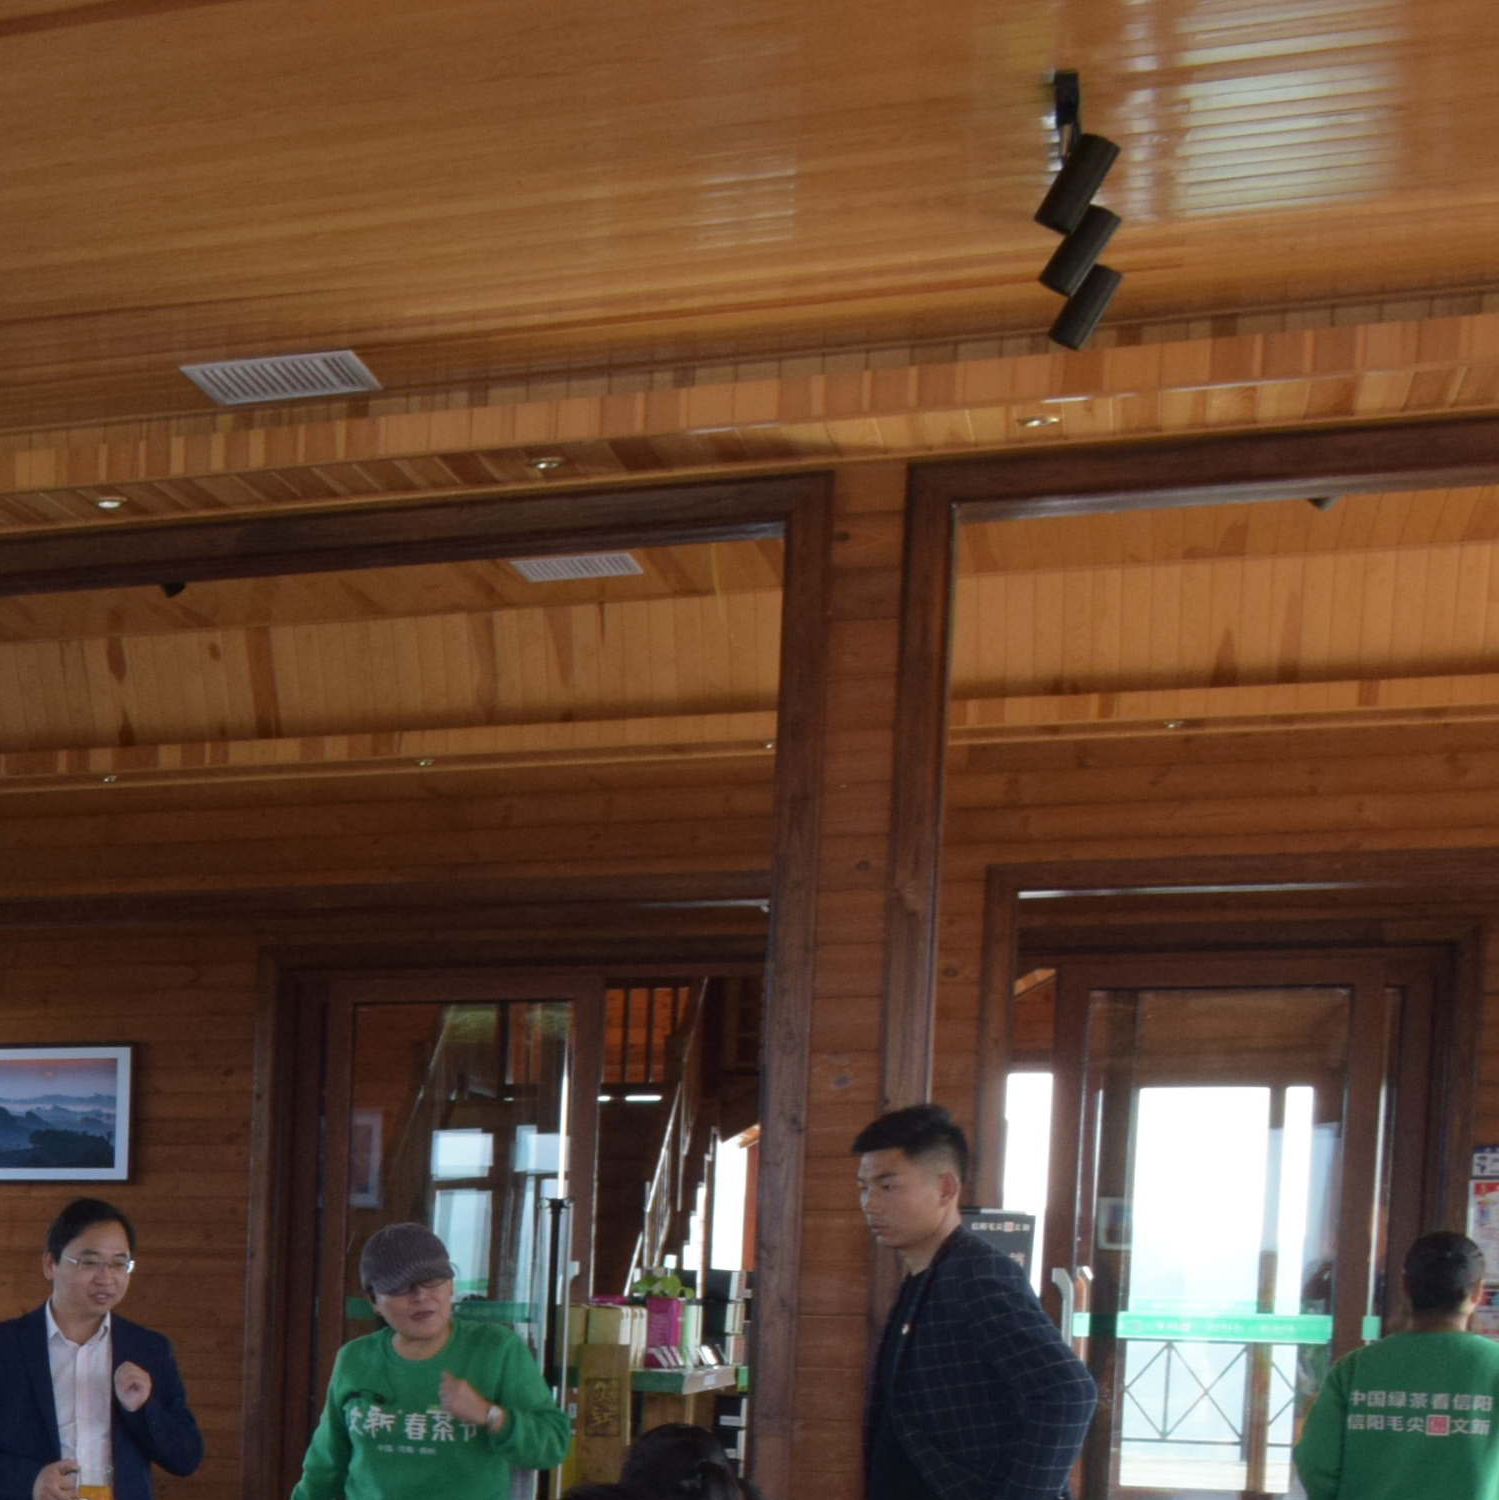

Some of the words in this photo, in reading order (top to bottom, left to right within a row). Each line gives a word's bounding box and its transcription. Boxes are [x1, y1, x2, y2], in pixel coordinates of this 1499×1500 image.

[1349, 1390, 1494, 1411] 中国绿茶看信阳
[1347, 1414, 1425, 1433] 信阳毛尖
[1450, 1418, 1491, 1435] 文新
